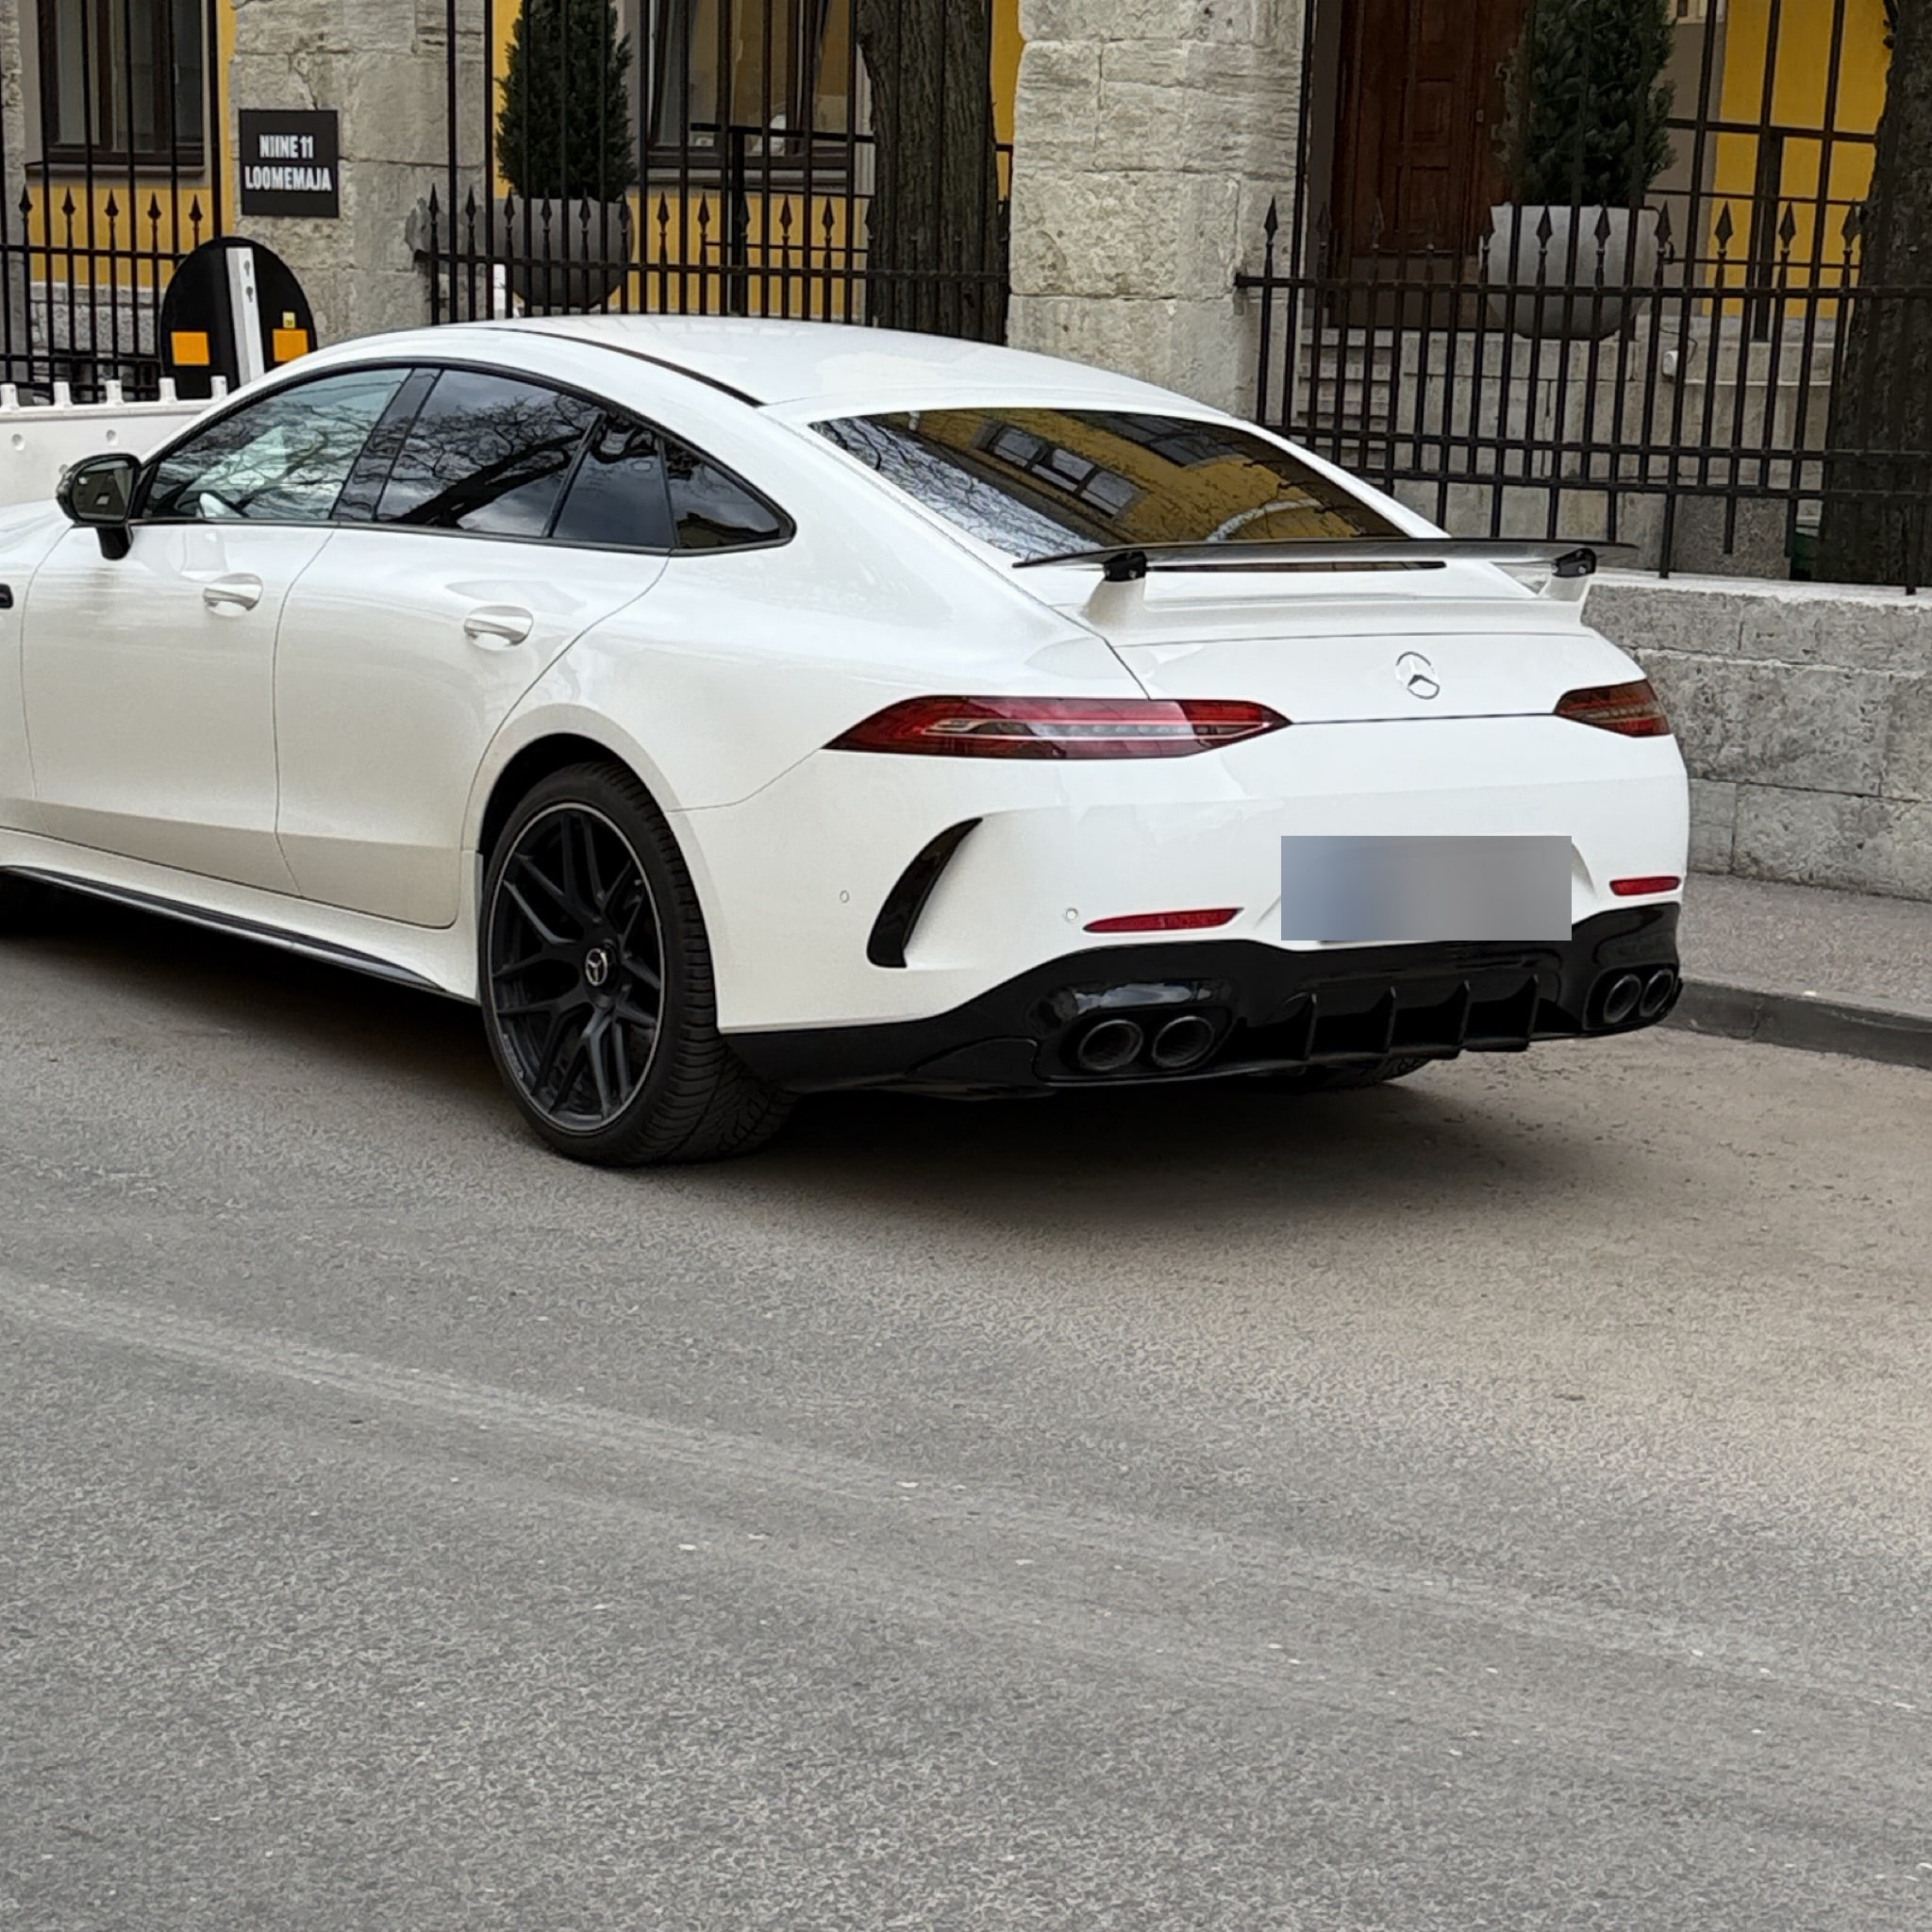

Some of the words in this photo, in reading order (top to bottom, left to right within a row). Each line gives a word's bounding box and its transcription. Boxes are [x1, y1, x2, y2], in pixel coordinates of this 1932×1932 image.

[258, 134, 298, 158] NIINE
[299, 135, 314, 158] 11
[244, 165, 332, 192] LOOMEMAJA
